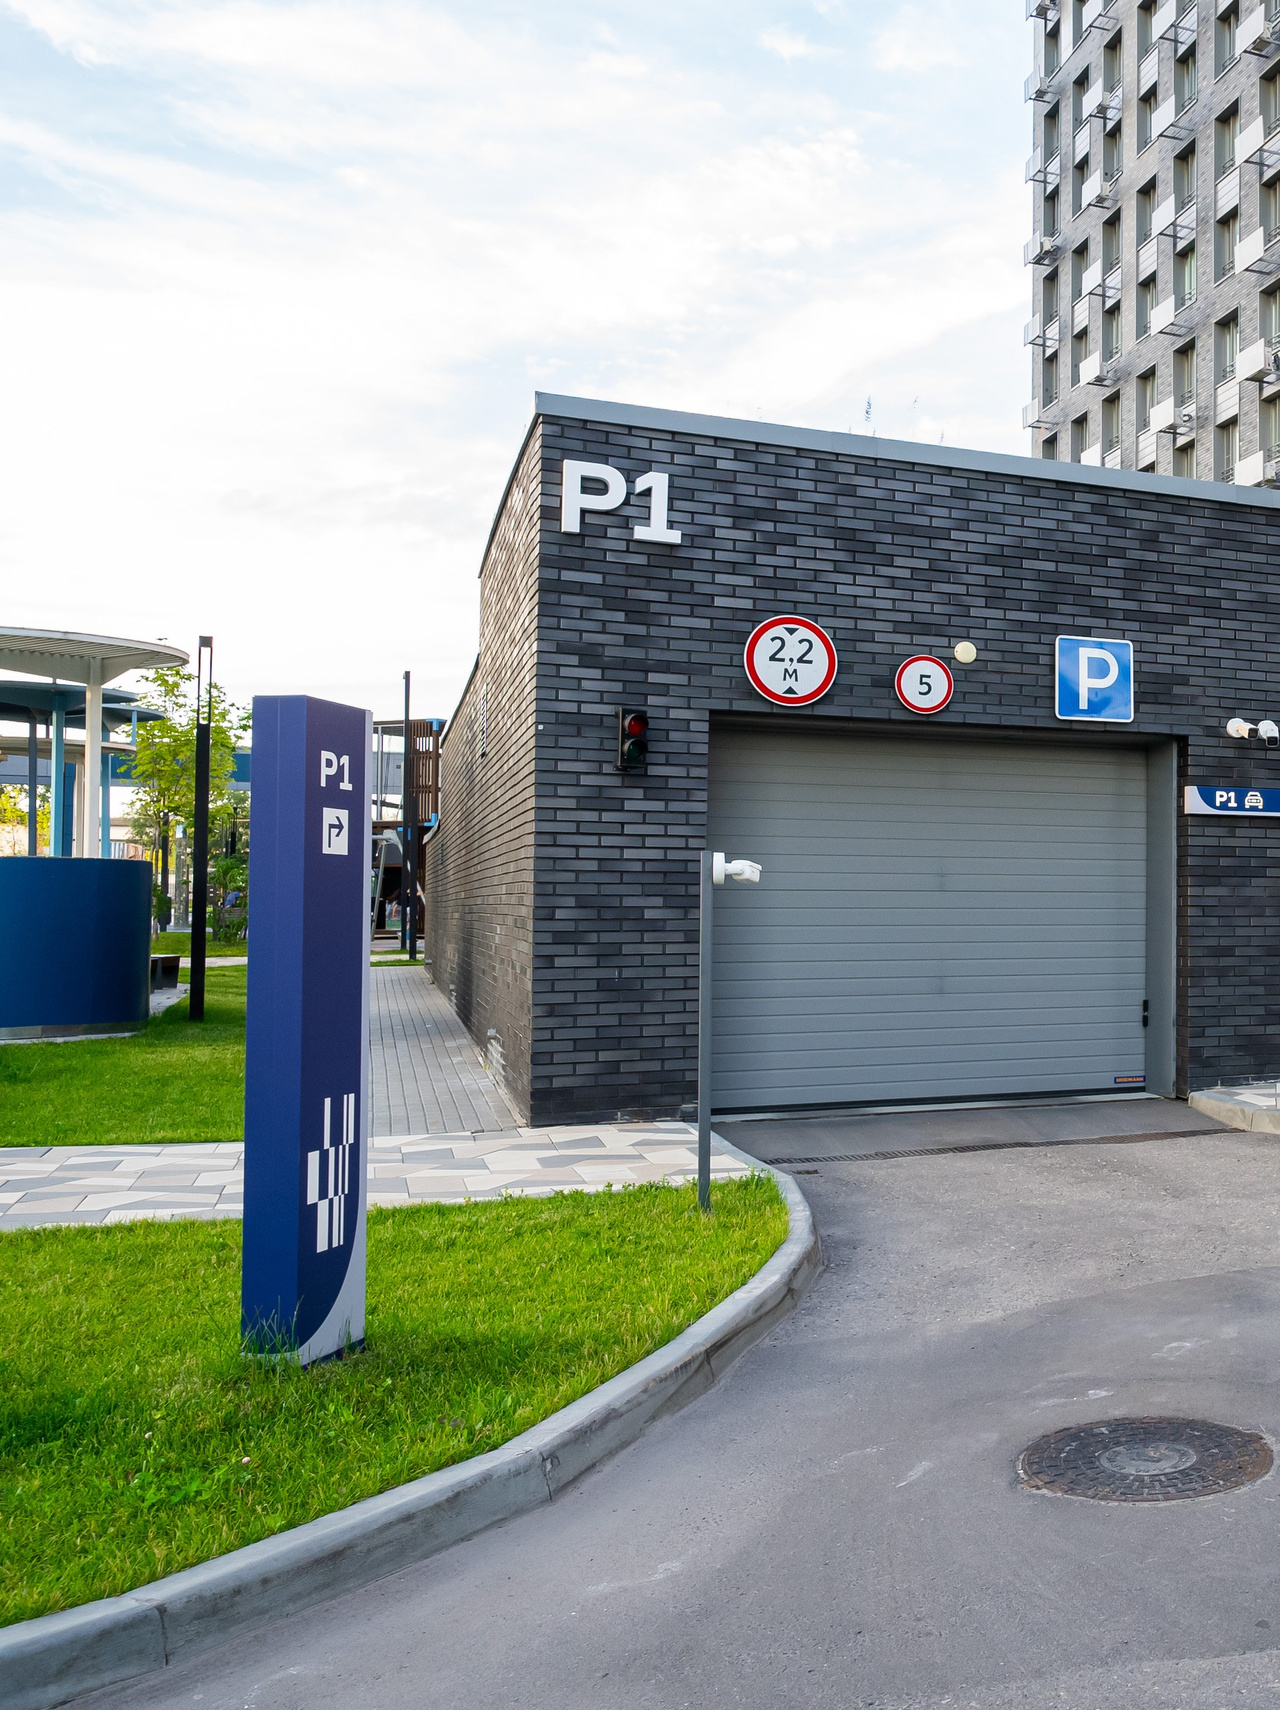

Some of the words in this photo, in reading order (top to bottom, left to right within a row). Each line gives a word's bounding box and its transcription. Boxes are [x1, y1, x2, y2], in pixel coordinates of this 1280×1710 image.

[560, 459, 682, 544] P1
[768, 635, 814, 667] 2,2
[918, 675, 932, 696] 5
[1078, 647, 1119, 710] P
[320, 750, 353, 791] P1
[1214, 790, 1238, 808] P1
